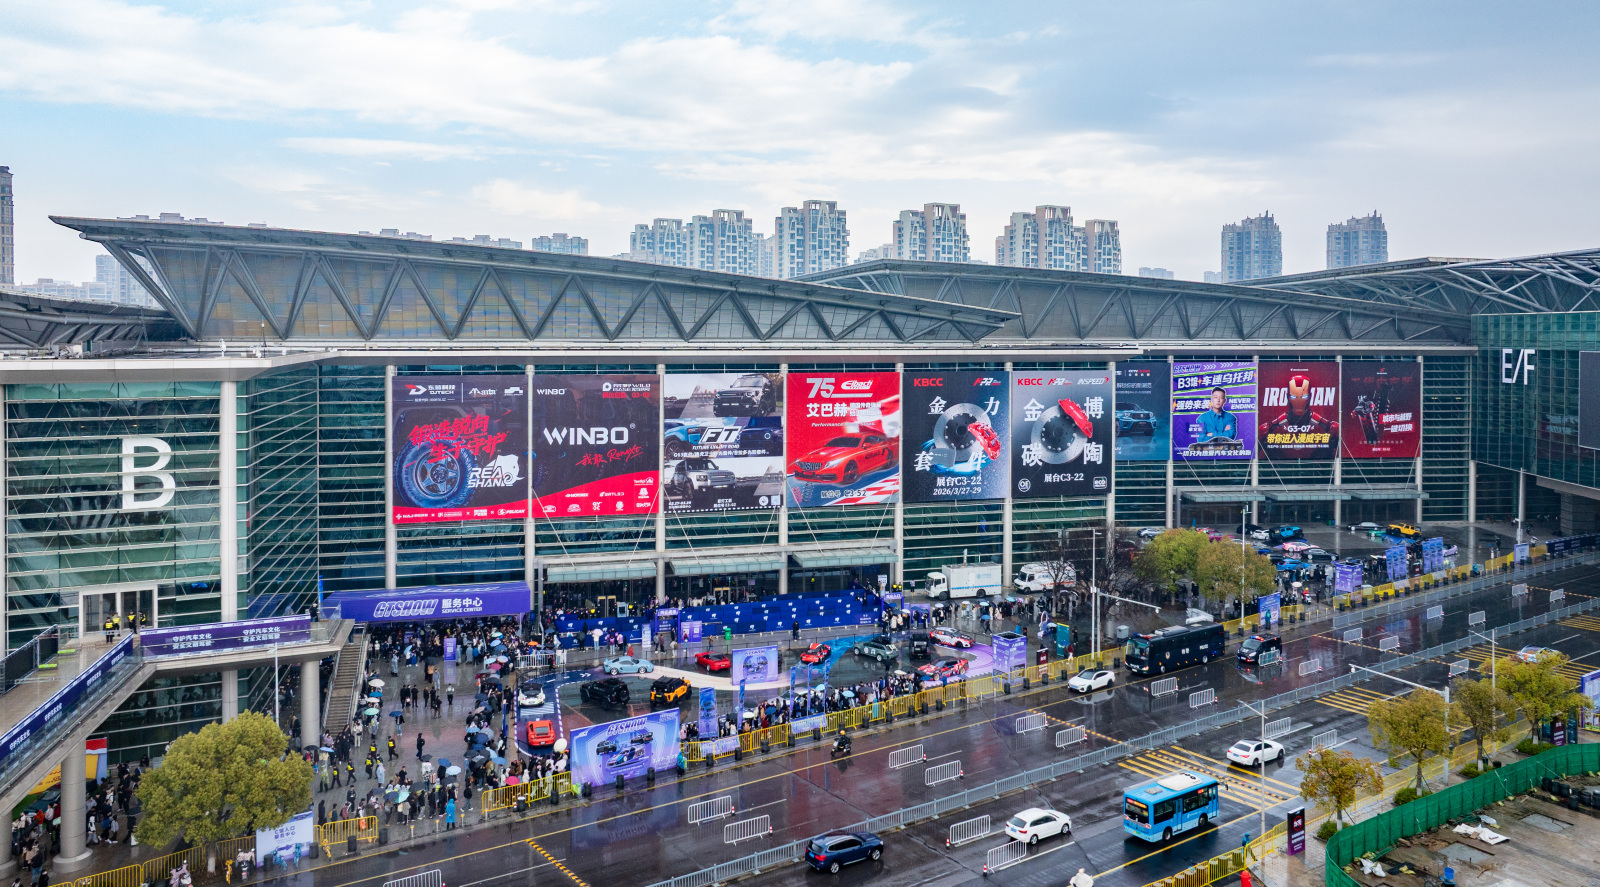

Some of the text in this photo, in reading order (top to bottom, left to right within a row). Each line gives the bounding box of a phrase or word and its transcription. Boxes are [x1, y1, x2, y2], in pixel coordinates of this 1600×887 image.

[1502, 348, 1536, 385] E/F
[806, 378, 836, 398] 75
[914, 378, 943, 387] KBCC
[1017, 378, 1042, 386] KBCC
[537, 389, 566, 398] WINBO
[1263, 387, 1290, 407] IRO
[806, 403, 848, 418] 艾巴赫
[928, 396, 1001, 416] 金 力
[1023, 397, 1104, 422] 金 博
[543, 427, 629, 446] WINBO
[1287, 425, 1311, 433] G3-07
[914, 451, 934, 472] 套
[1021, 441, 1104, 467] 碳 陶
[122, 437, 176, 509] B
[933, 487, 982, 497] 2026/3/27-29
[373, 599, 439, 618] GTSHOW
[441, 597, 482, 609] 服务中心
[173, 633, 212, 643] 守护汽车文化
[606, 717, 648, 737] GTSHOW
